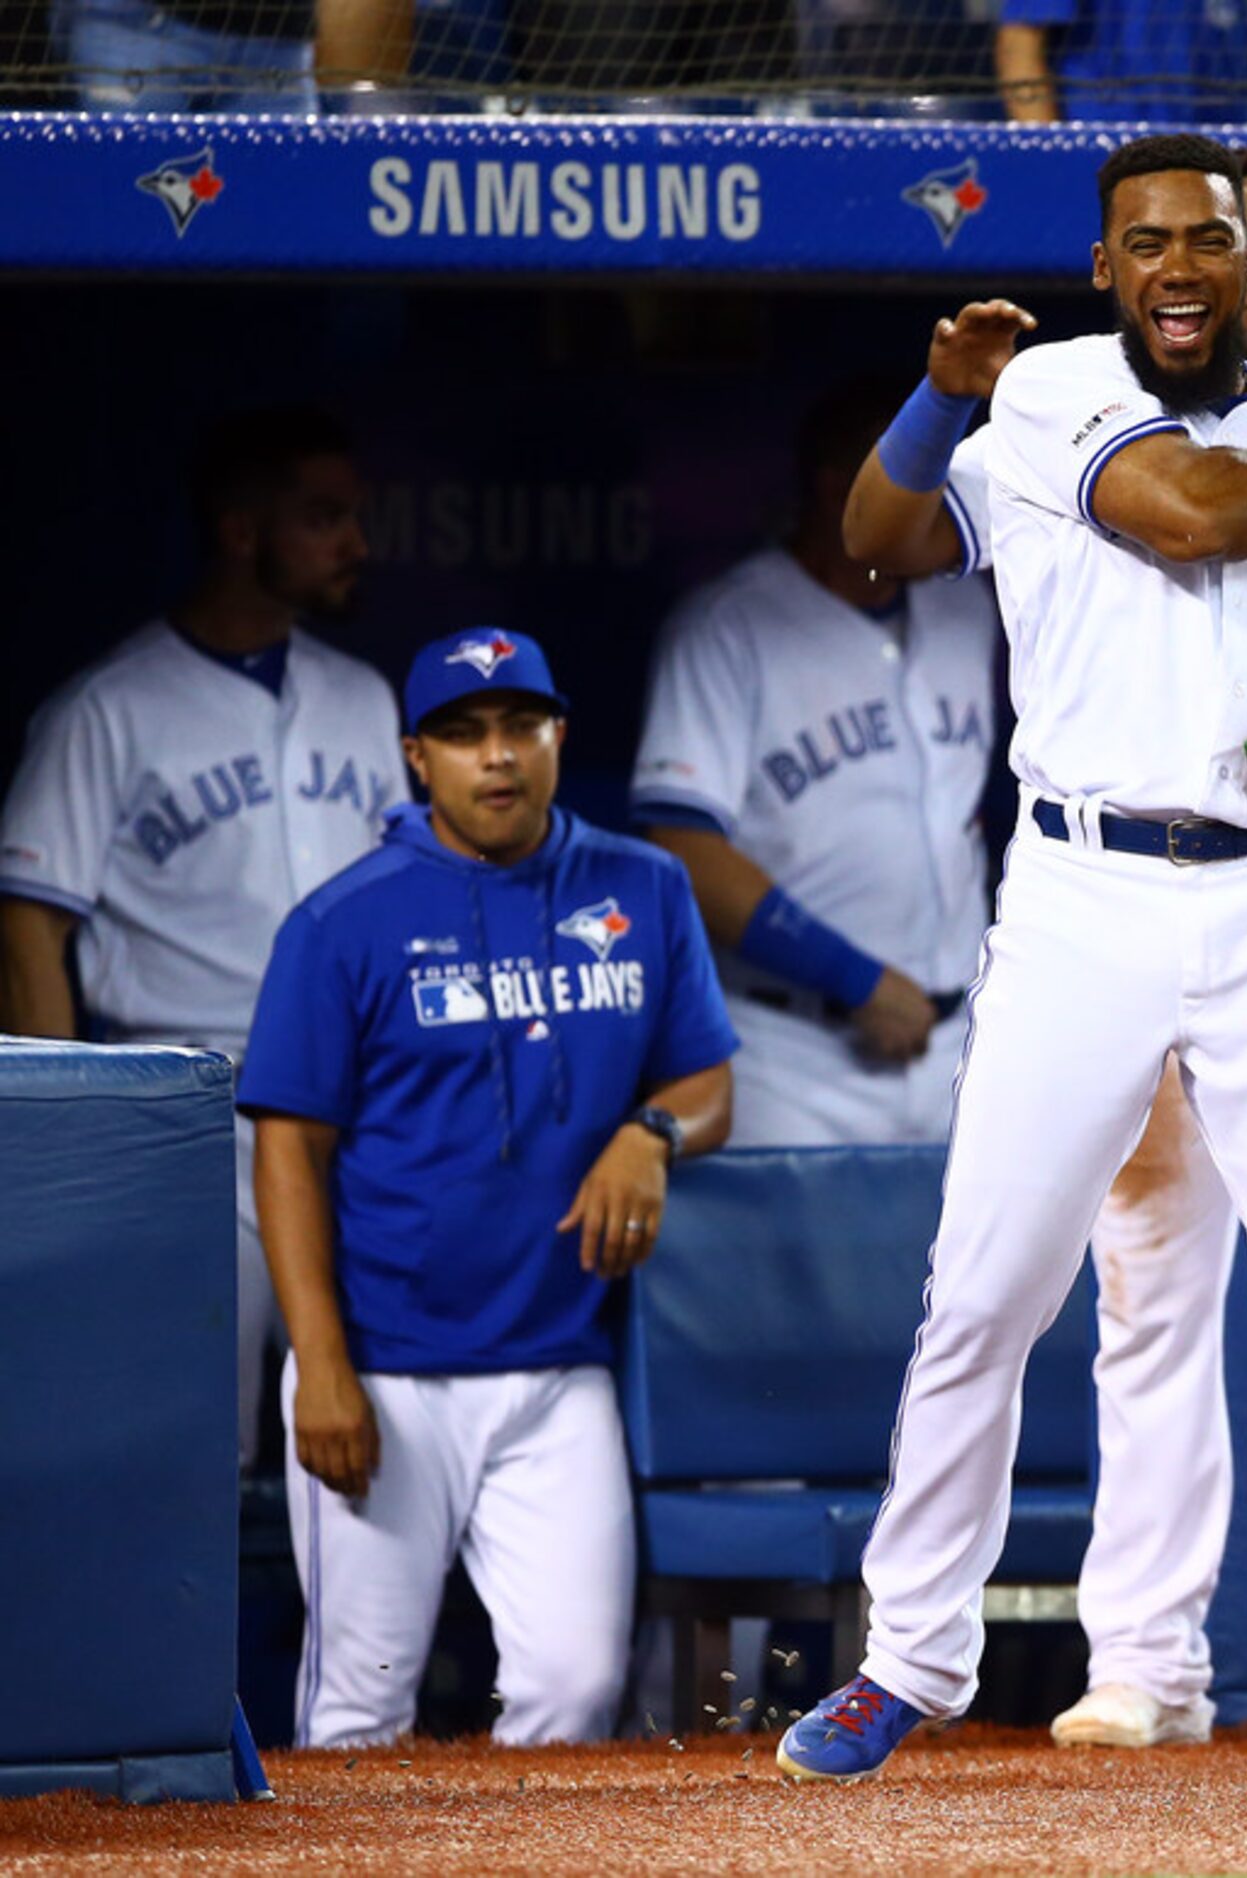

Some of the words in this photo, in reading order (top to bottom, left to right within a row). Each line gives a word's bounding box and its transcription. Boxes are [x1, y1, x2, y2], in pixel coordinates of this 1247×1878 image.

[368, 157, 760, 241] SAMSUNG
[761, 697, 897, 805] BLUE
[133, 751, 274, 868] BLUE
[577, 961, 644, 1012] JAYS
